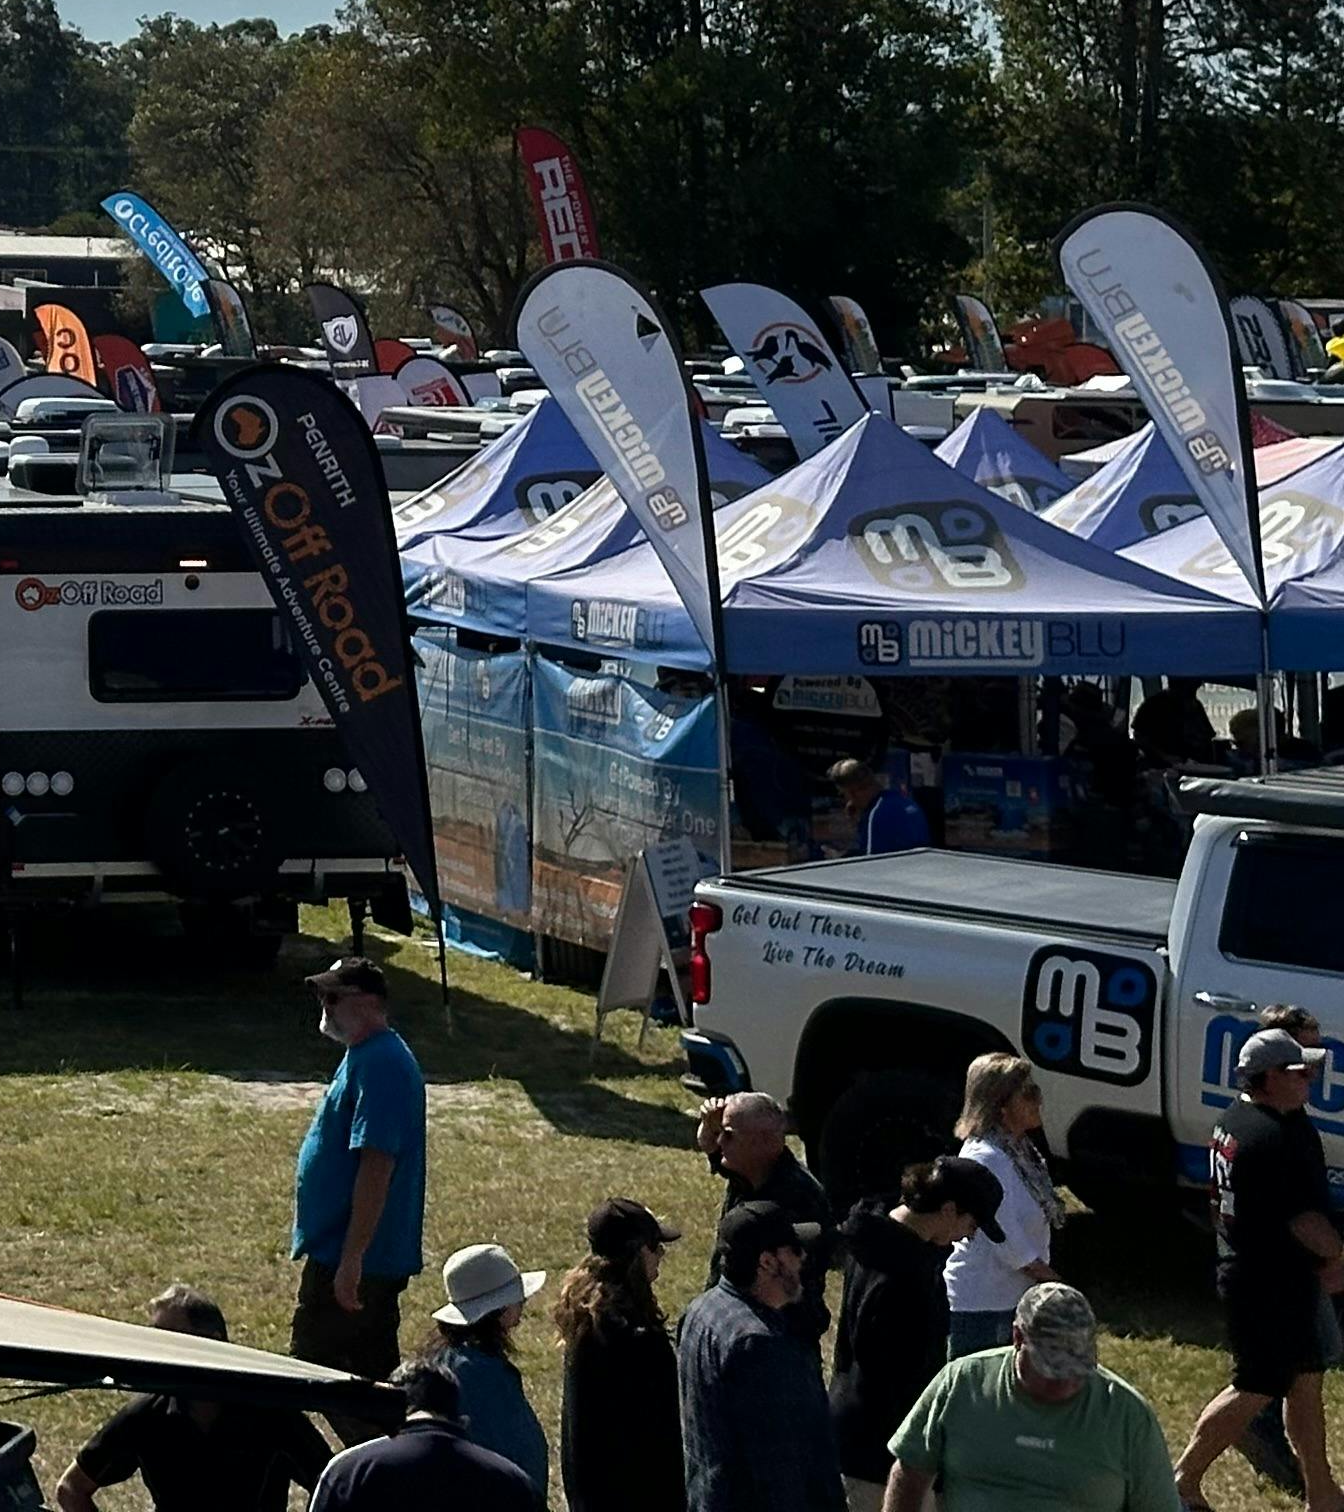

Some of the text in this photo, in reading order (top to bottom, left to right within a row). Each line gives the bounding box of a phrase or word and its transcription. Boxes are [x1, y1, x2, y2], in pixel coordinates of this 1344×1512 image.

[296, 412, 358, 509] PENRITH
[225, 469, 249, 505] Your
[242, 506, 282, 576] Ultimate
[276, 576, 322, 657] Adventure
[317, 657, 351, 714] Centre
[792, 677, 842, 689] Powered
[732, 903, 760, 927] Get
[768, 909, 800, 930] Out
[761, 940, 906, 979] Live The Dream
